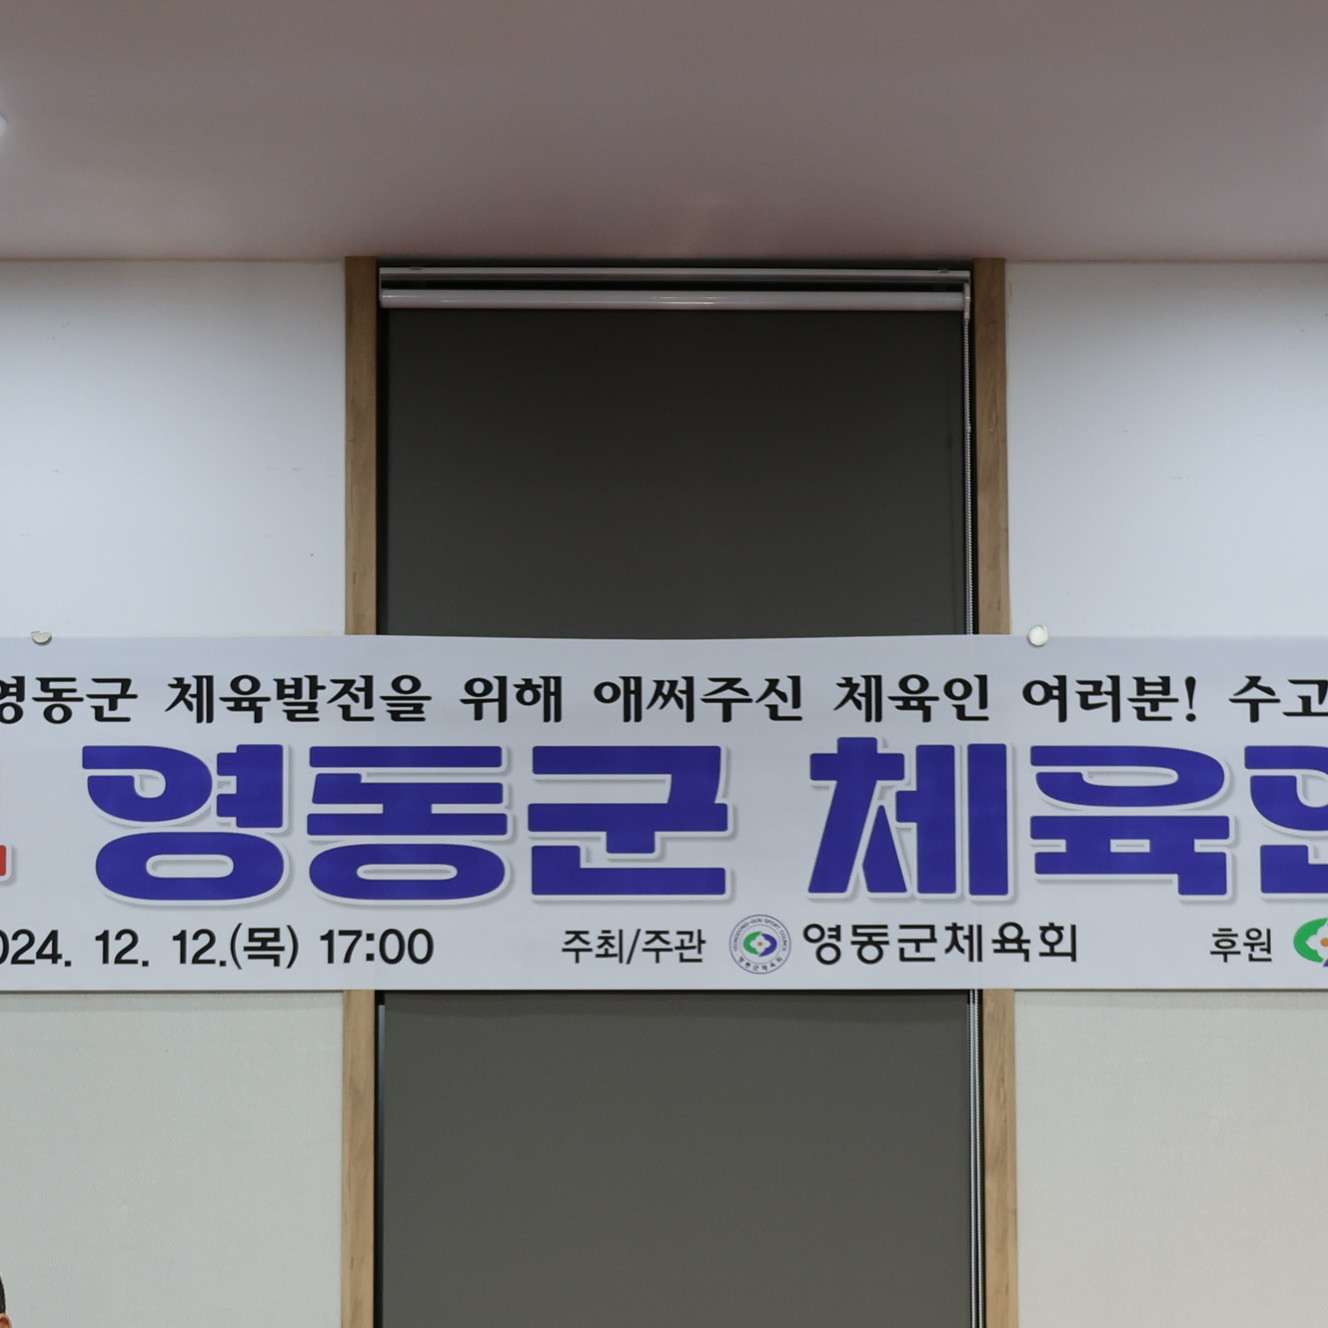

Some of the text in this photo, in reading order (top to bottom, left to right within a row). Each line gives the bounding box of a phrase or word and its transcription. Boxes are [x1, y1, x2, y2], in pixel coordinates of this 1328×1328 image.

[165, 674, 432, 724] 체육발전을
[459, 675, 562, 723] 위해
[593, 675, 803, 723] 애써주신
[833, 674, 990, 723] 체육인
[1022, 674, 1197, 723] 여러분!
[82, 744, 728, 901] 영동군
[95, 928, 149, 967] 12.
[172, 922, 299, 970] 12.(목)
[320, 928, 434, 965] 17:00
[561, 928, 706, 965] 주최/주관
[803, 921, 1077, 966] 영동군체육회
[1210, 928, 1272, 963] 후원
